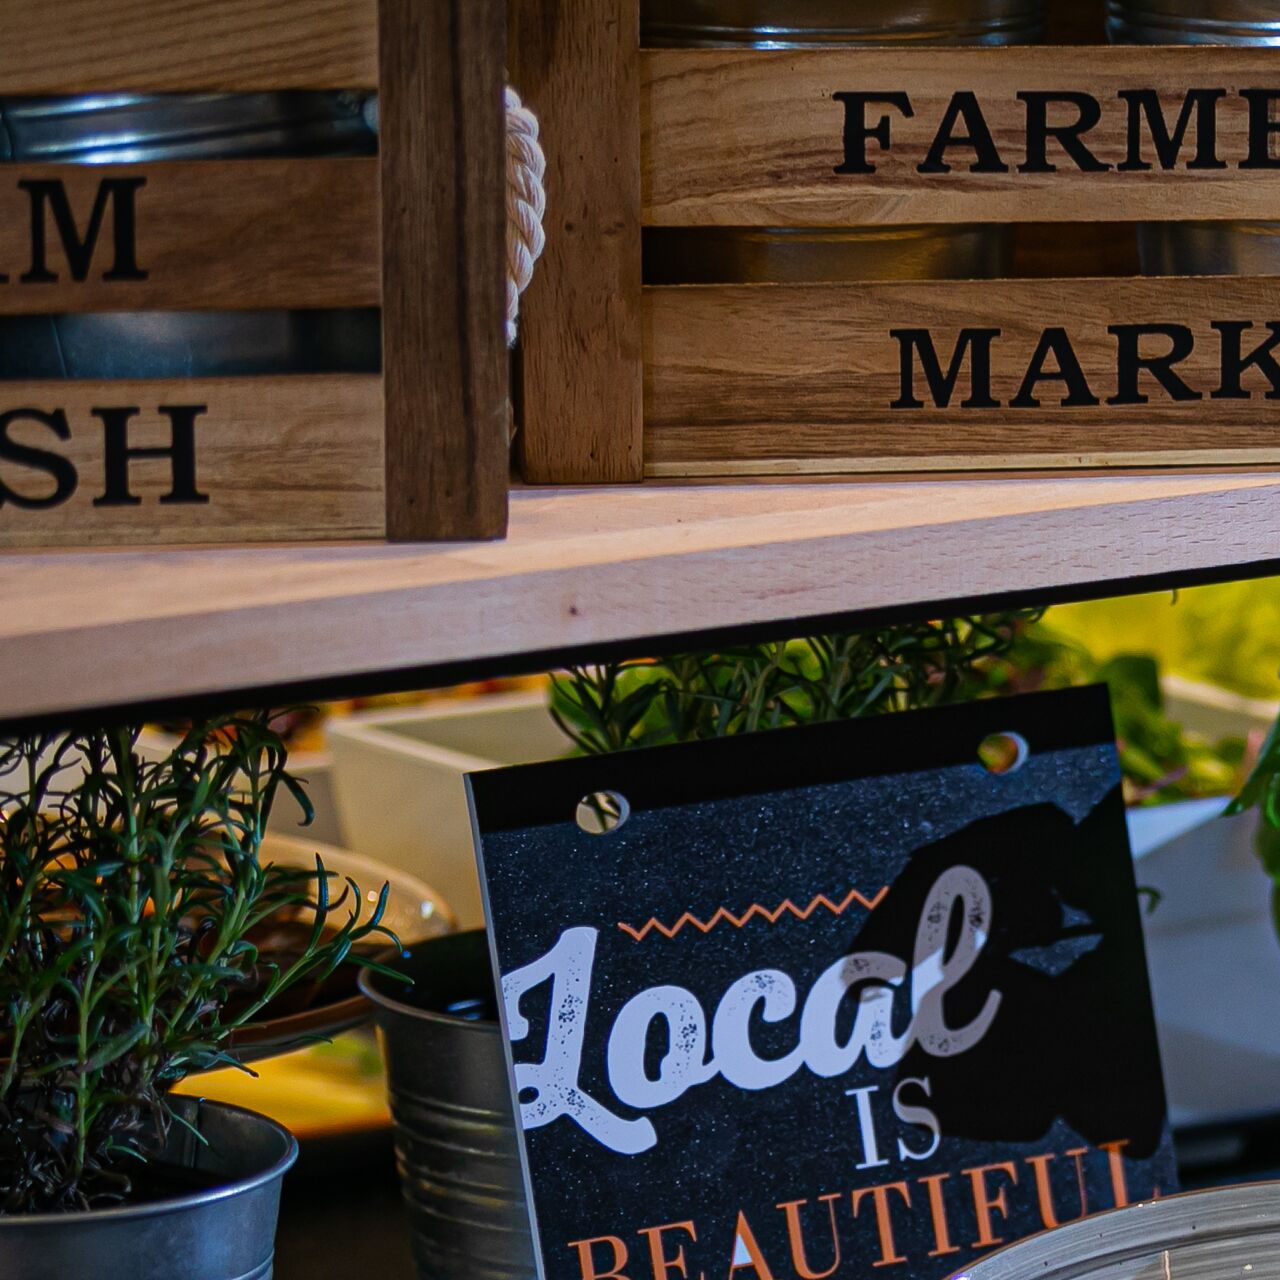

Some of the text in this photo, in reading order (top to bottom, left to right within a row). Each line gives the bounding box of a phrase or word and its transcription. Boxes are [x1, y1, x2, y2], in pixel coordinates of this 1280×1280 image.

[0, 175, 149, 285] M
[0, 404, 210, 511] SH
[501, 864, 1003, 1155] Local
[845, 1075, 942, 1171] IS
